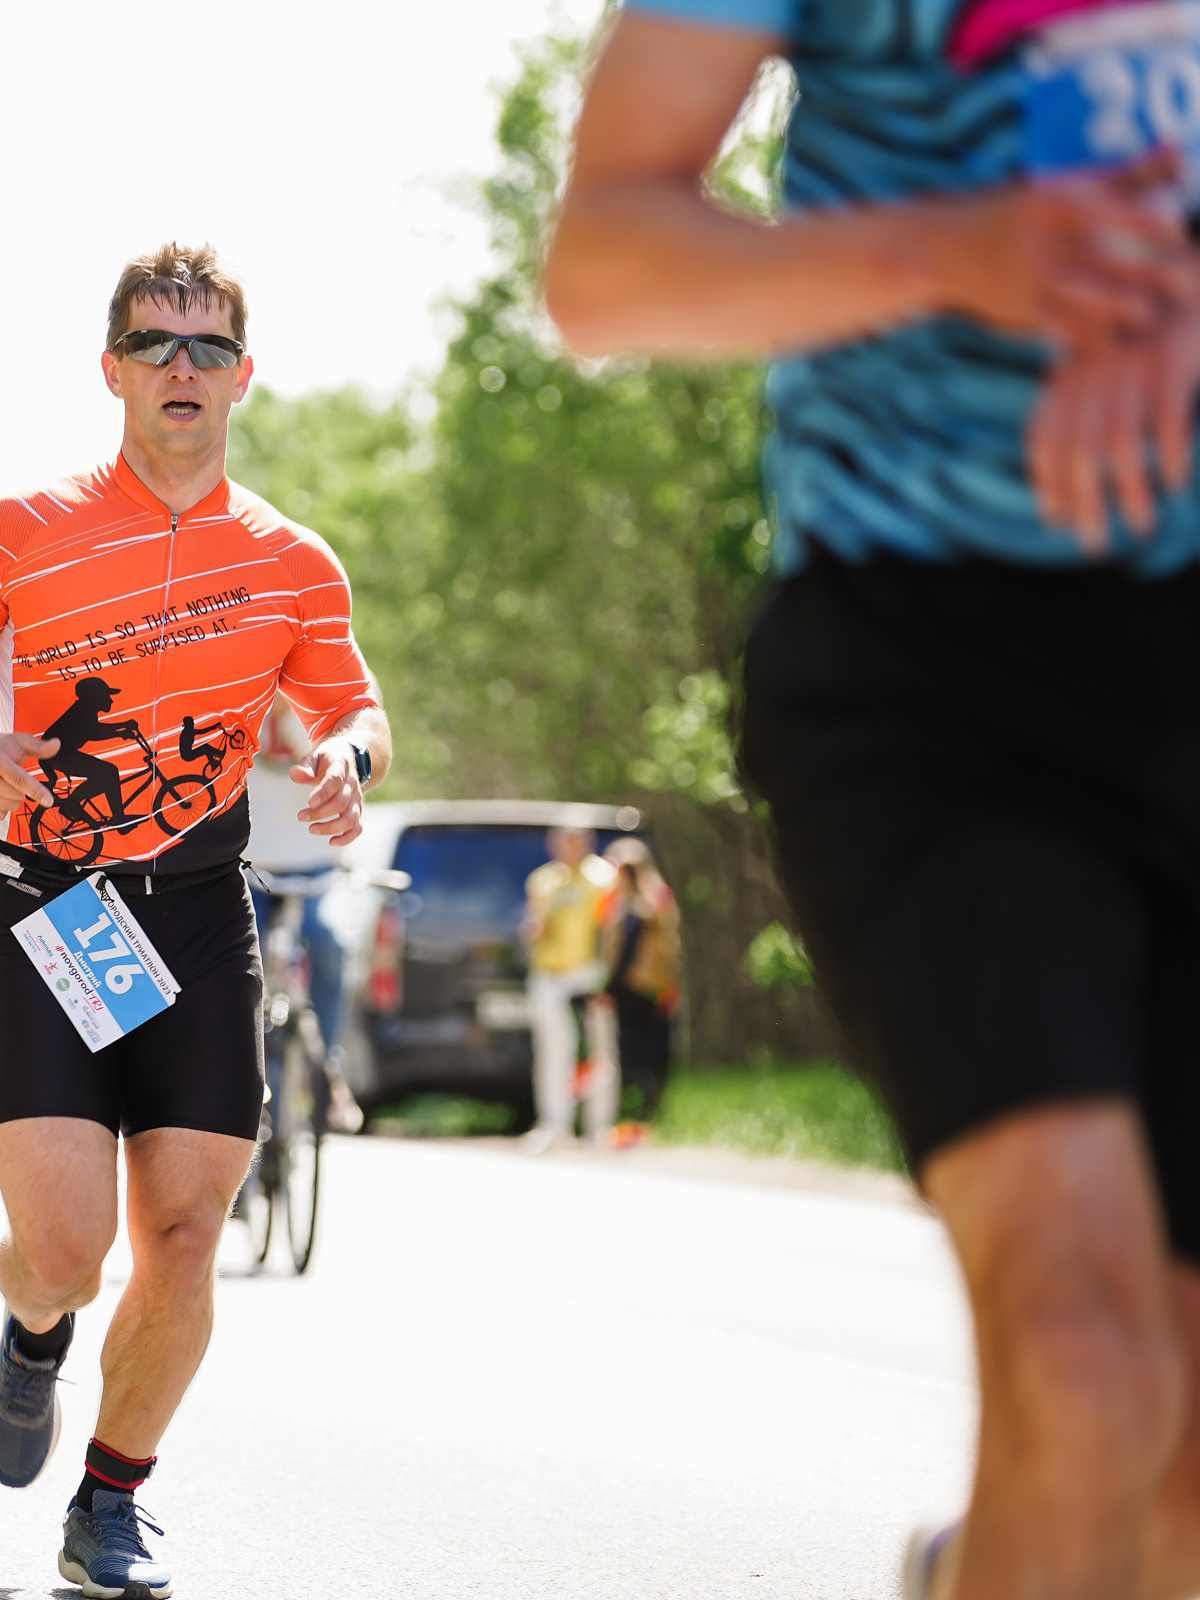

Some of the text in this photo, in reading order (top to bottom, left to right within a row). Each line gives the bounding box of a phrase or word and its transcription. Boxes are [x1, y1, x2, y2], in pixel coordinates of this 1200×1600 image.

[16, 587, 251, 668] THE WORLD IS SO THAT NOTHING
[58, 618, 236, 681] IS TO BE SURPISED AT.
[72, 949, 102, 989] Дмитрий
[73, 912, 145, 995] 176
[132, 940, 160, 978] ТРИАТЛОН
[156, 976, 171, 995] 2023
